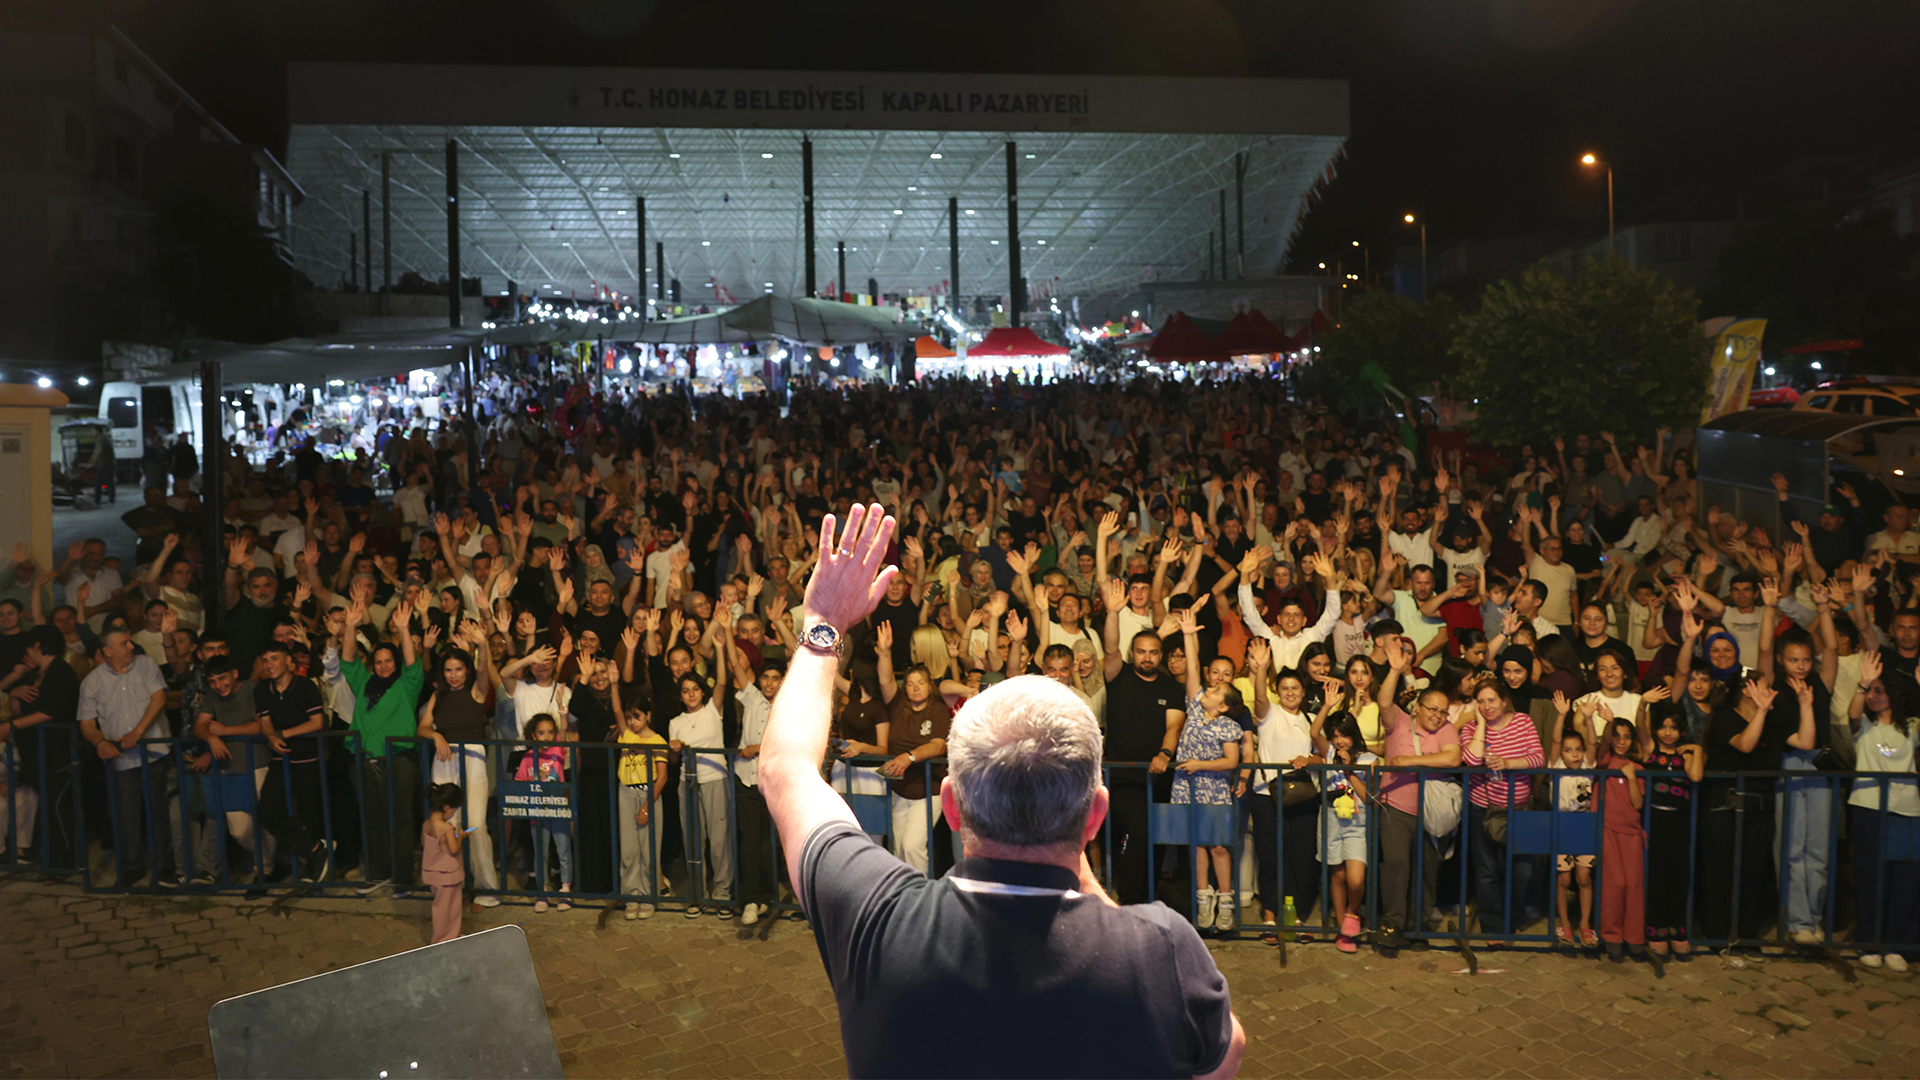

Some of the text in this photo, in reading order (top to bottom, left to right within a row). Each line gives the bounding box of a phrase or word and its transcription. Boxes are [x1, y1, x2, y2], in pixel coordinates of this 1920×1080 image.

[600, 84, 1089, 114] T.C. HONAZ BELEDİYESİ KAPALI PAZARYERİ
[530, 784, 543, 792] T.C.
[505, 795, 529, 804] HONAZ
[503, 807, 527, 816] ZABITA
